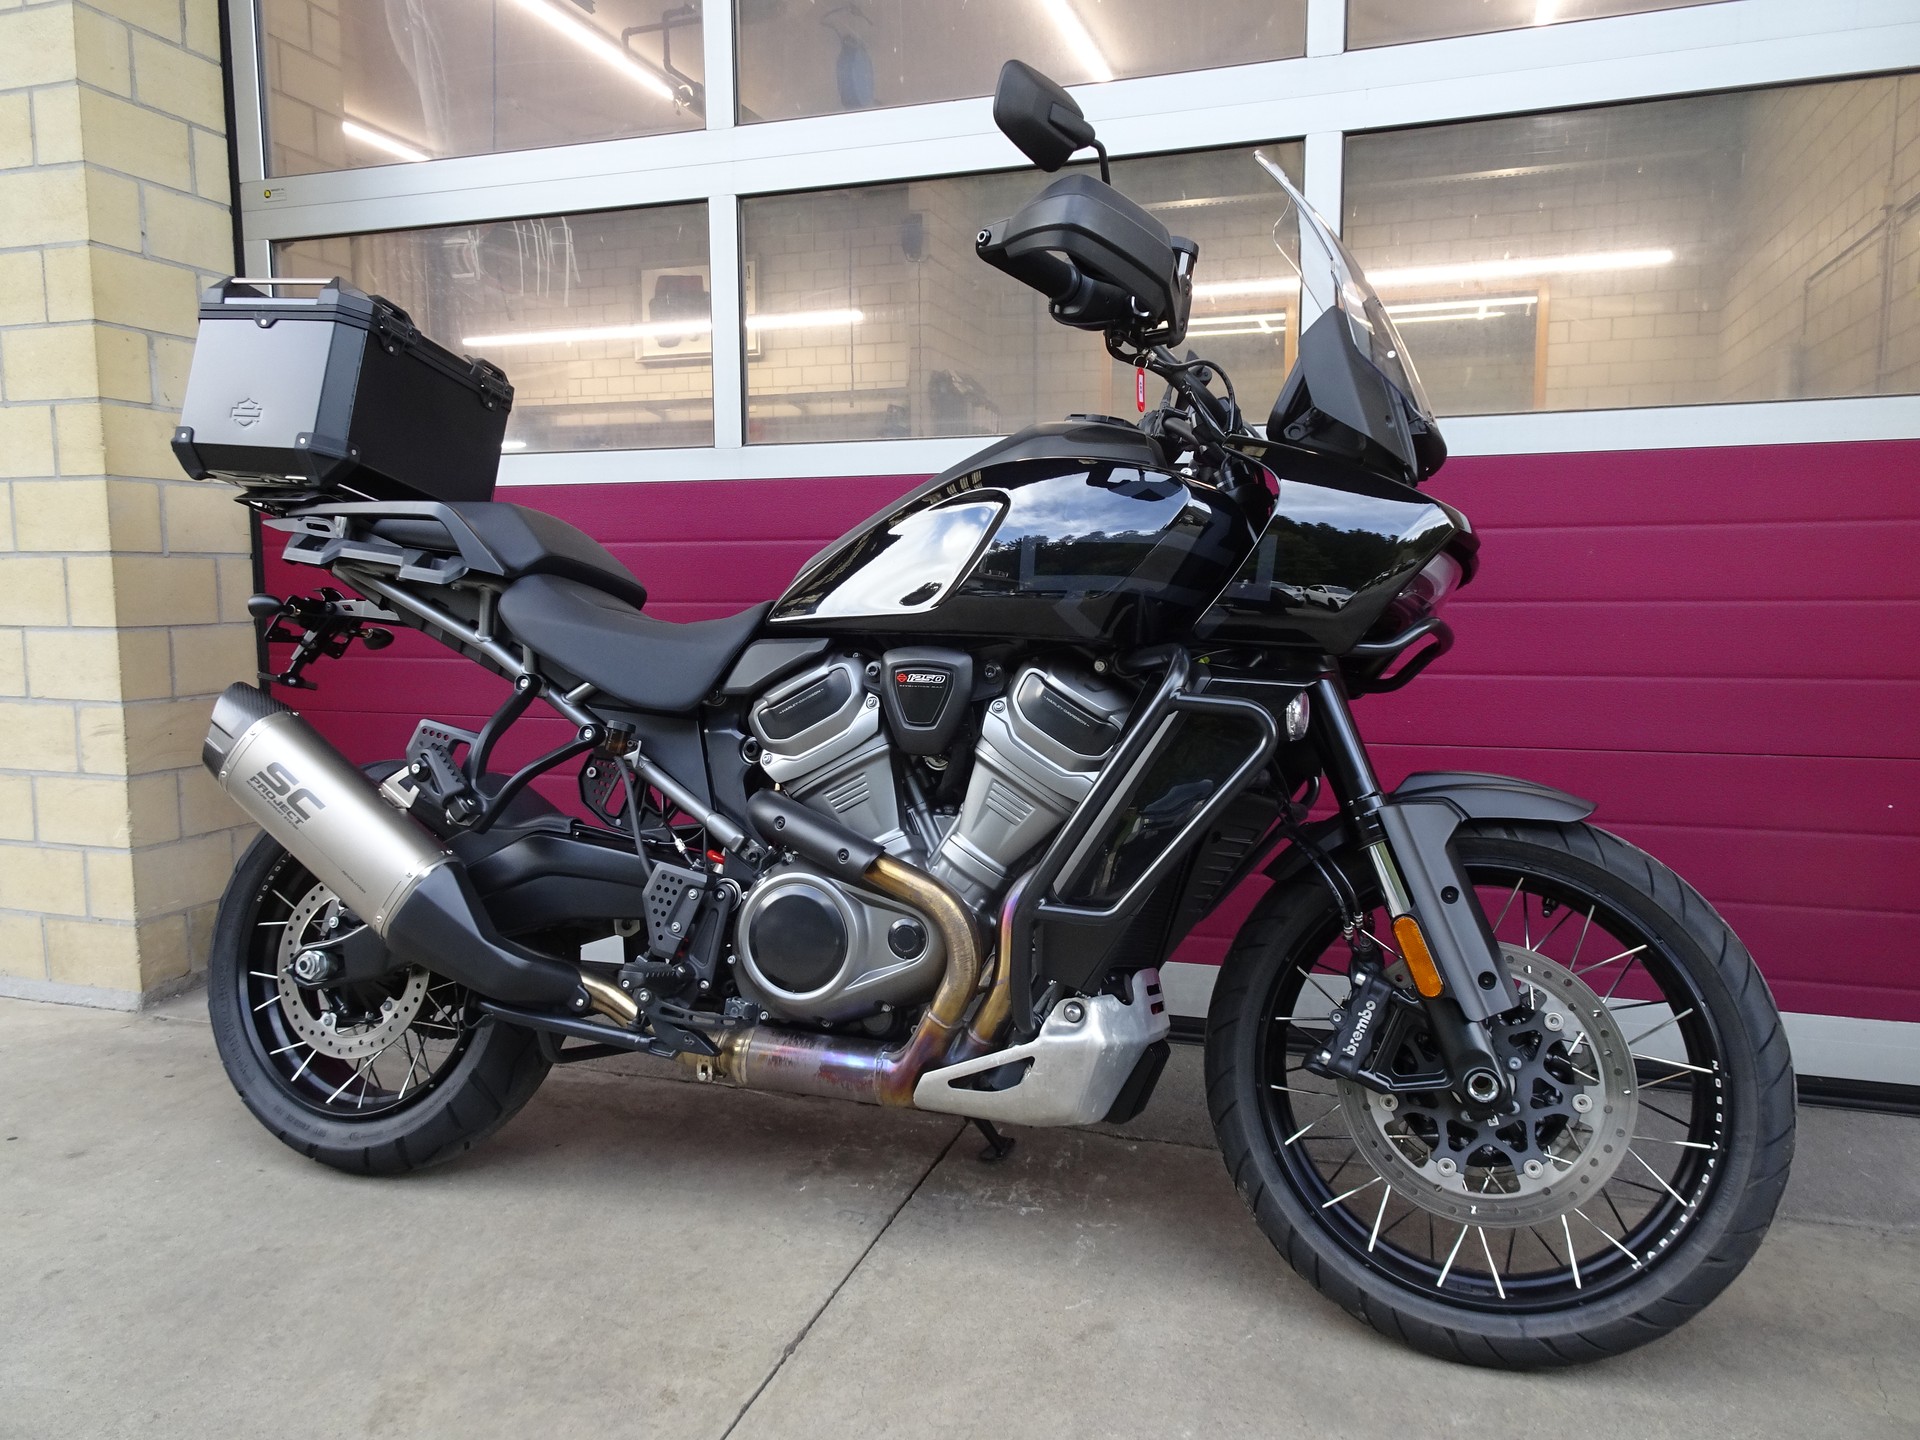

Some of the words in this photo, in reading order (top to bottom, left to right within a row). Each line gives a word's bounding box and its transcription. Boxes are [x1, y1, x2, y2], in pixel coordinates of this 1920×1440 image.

[249, 776, 304, 825] PROJECT
[256, 762, 326, 821] SC
[1342, 1000, 1376, 1057] brembo
